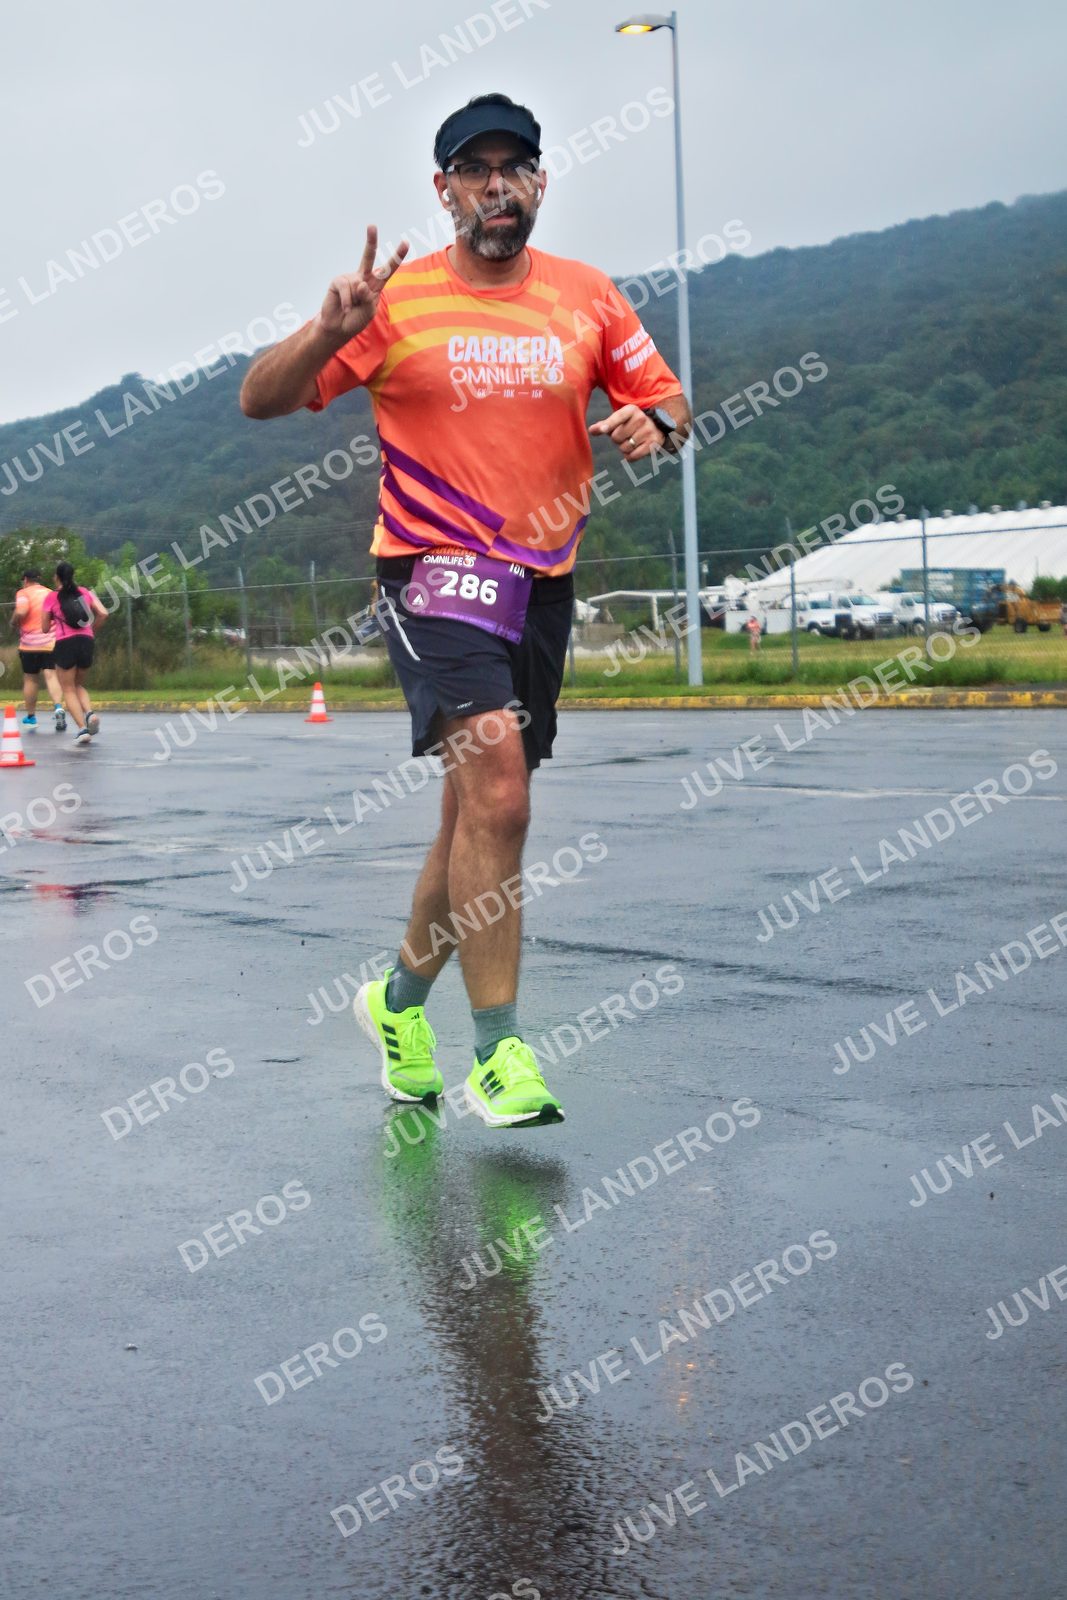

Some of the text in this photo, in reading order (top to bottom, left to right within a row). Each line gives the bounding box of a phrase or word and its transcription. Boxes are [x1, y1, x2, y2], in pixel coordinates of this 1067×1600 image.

[448, 335, 564, 362] CARRERA
[450, 366, 541, 385] OMNILIFE
[423, 555, 464, 566] OMNILIFE
[439, 570, 499, 605] 286
